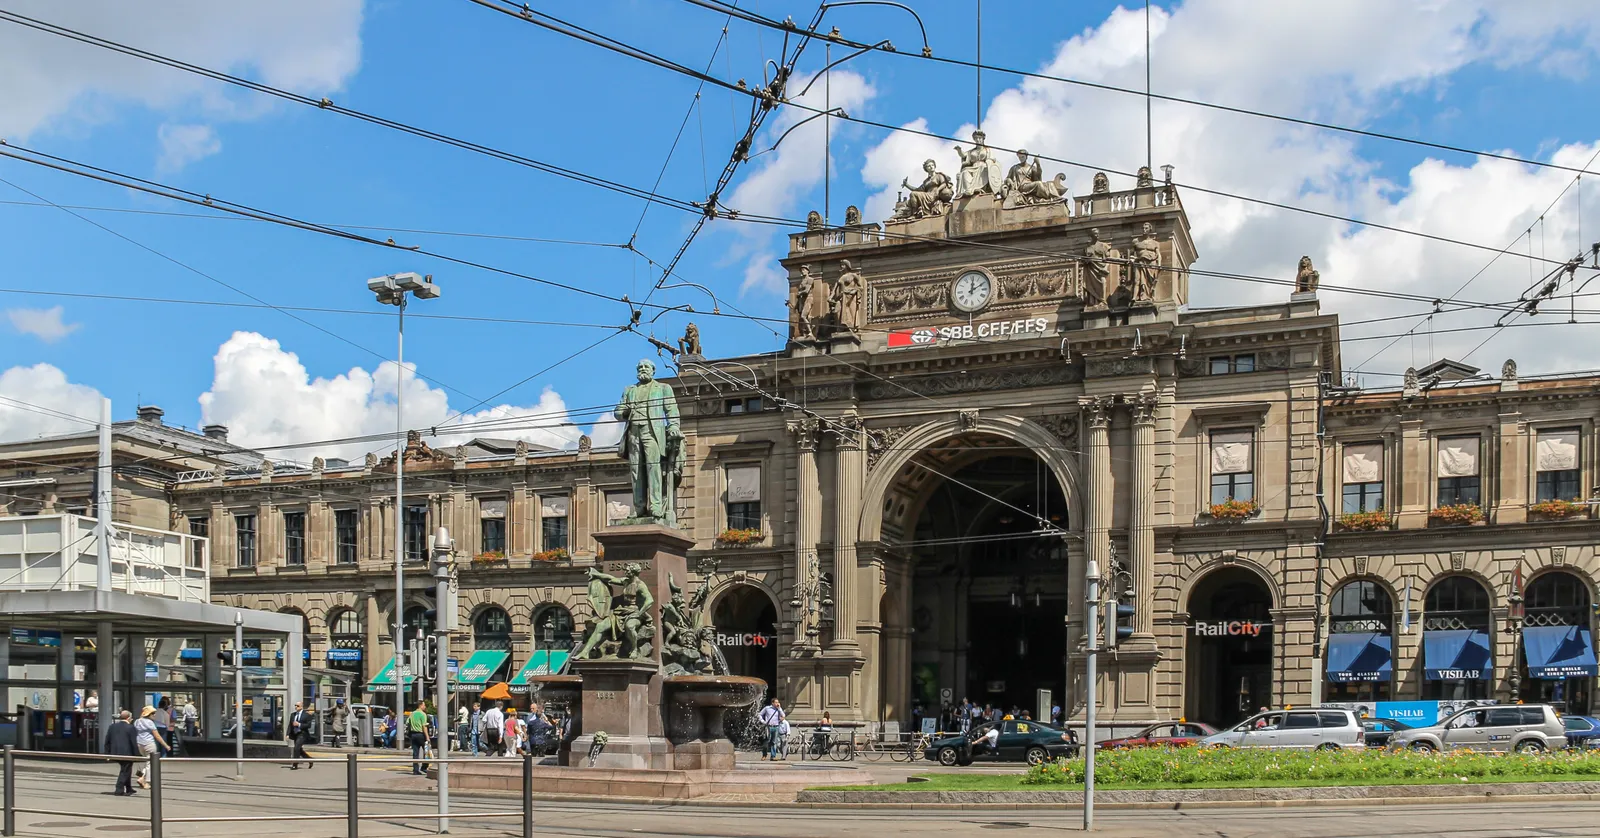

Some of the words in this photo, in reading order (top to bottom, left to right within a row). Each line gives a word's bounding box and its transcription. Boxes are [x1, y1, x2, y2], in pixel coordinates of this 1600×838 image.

[941, 325, 973, 340] SBB
[978, 317, 1048, 338] CFF/FFS
[609, 561, 651, 571] ESCER
[1195, 620, 1262, 637] RailCity
[716, 632, 770, 648] RailCity
[1438, 669, 1480, 679] VISILAB
[1389, 709, 1424, 717] VISILAB
